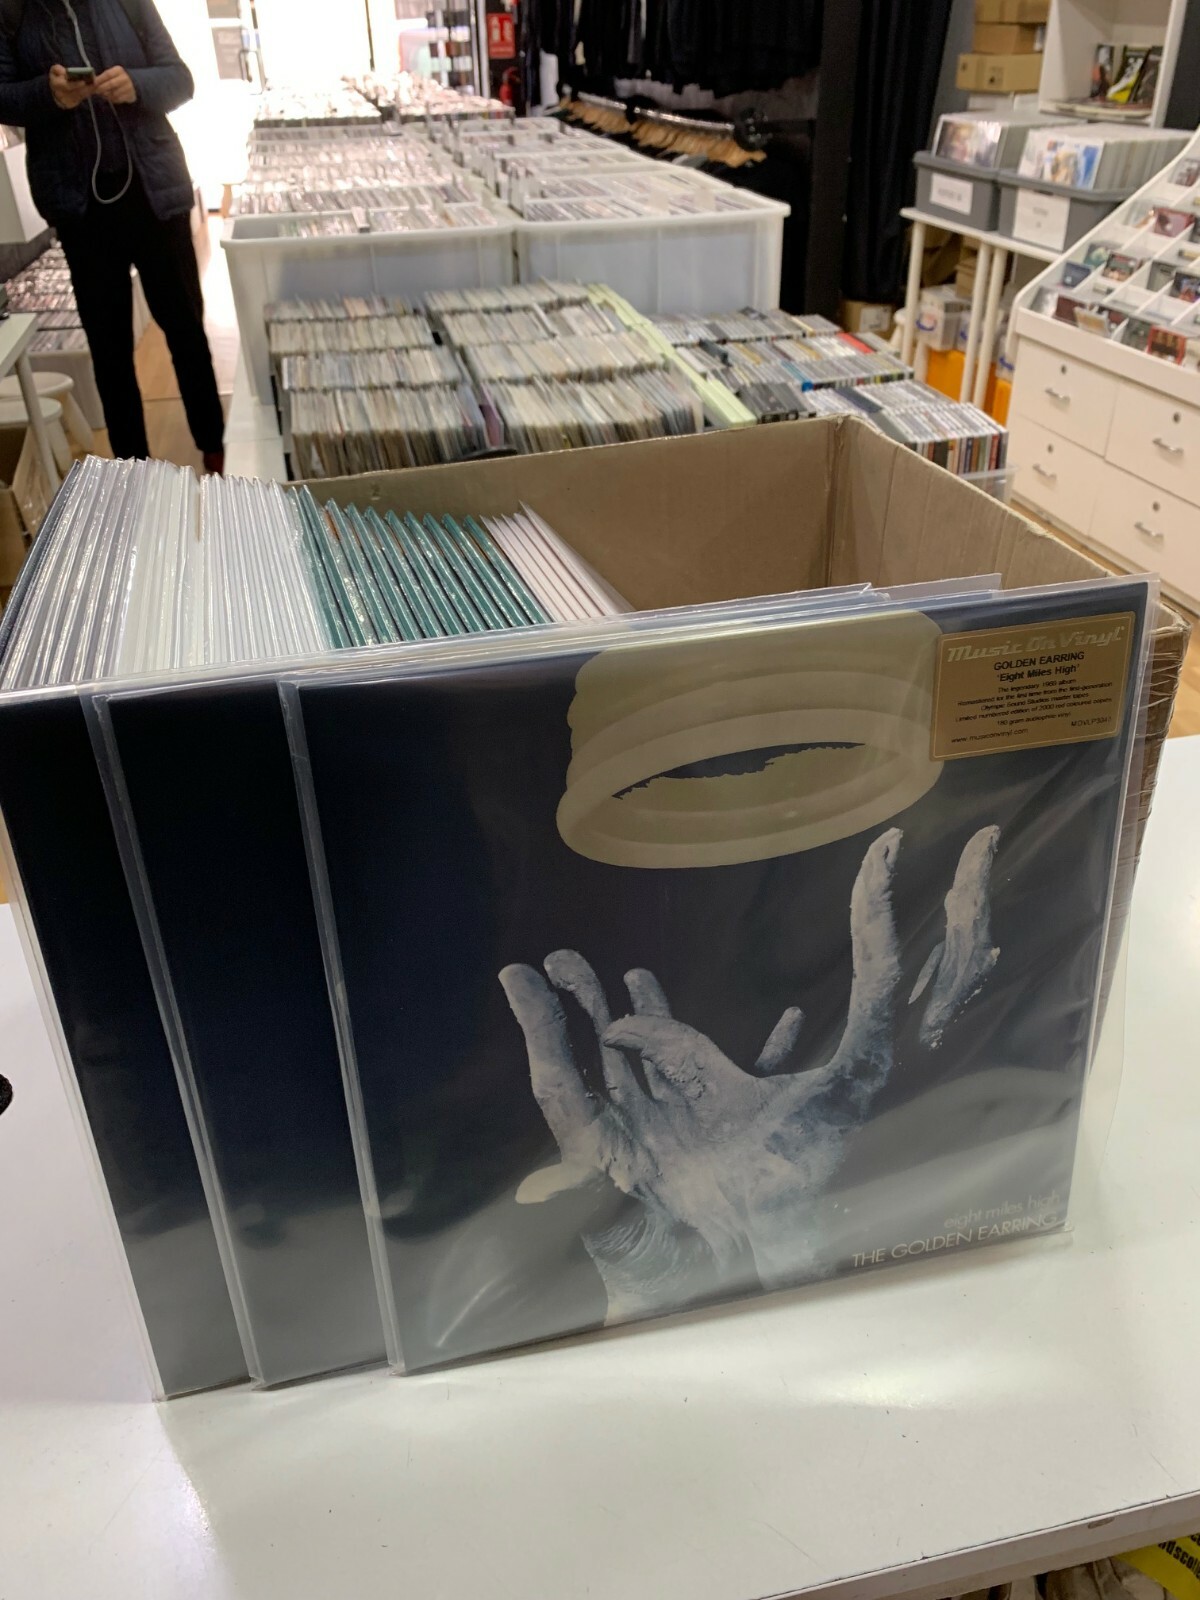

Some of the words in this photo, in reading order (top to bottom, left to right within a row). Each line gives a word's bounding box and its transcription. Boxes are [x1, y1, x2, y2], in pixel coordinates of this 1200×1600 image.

[948, 641, 1022, 662] Music
[1026, 636, 1056, 652] On
[1061, 626, 1121, 647] Vinyl
[994, 658, 1036, 670] GOLDEN
[1039, 651, 1085, 665] EARRING
[1027, 668, 1052, 678] Miles
[1010, 684, 1039, 692] legendary
[944, 1208, 983, 1229] eight
[985, 1200, 1023, 1219] miles
[1028, 1190, 1060, 1212] high
[852, 1247, 886, 1267] THE
[891, 1228, 972, 1259] GOLDEN
[978, 1211, 1058, 1241] EARRING
